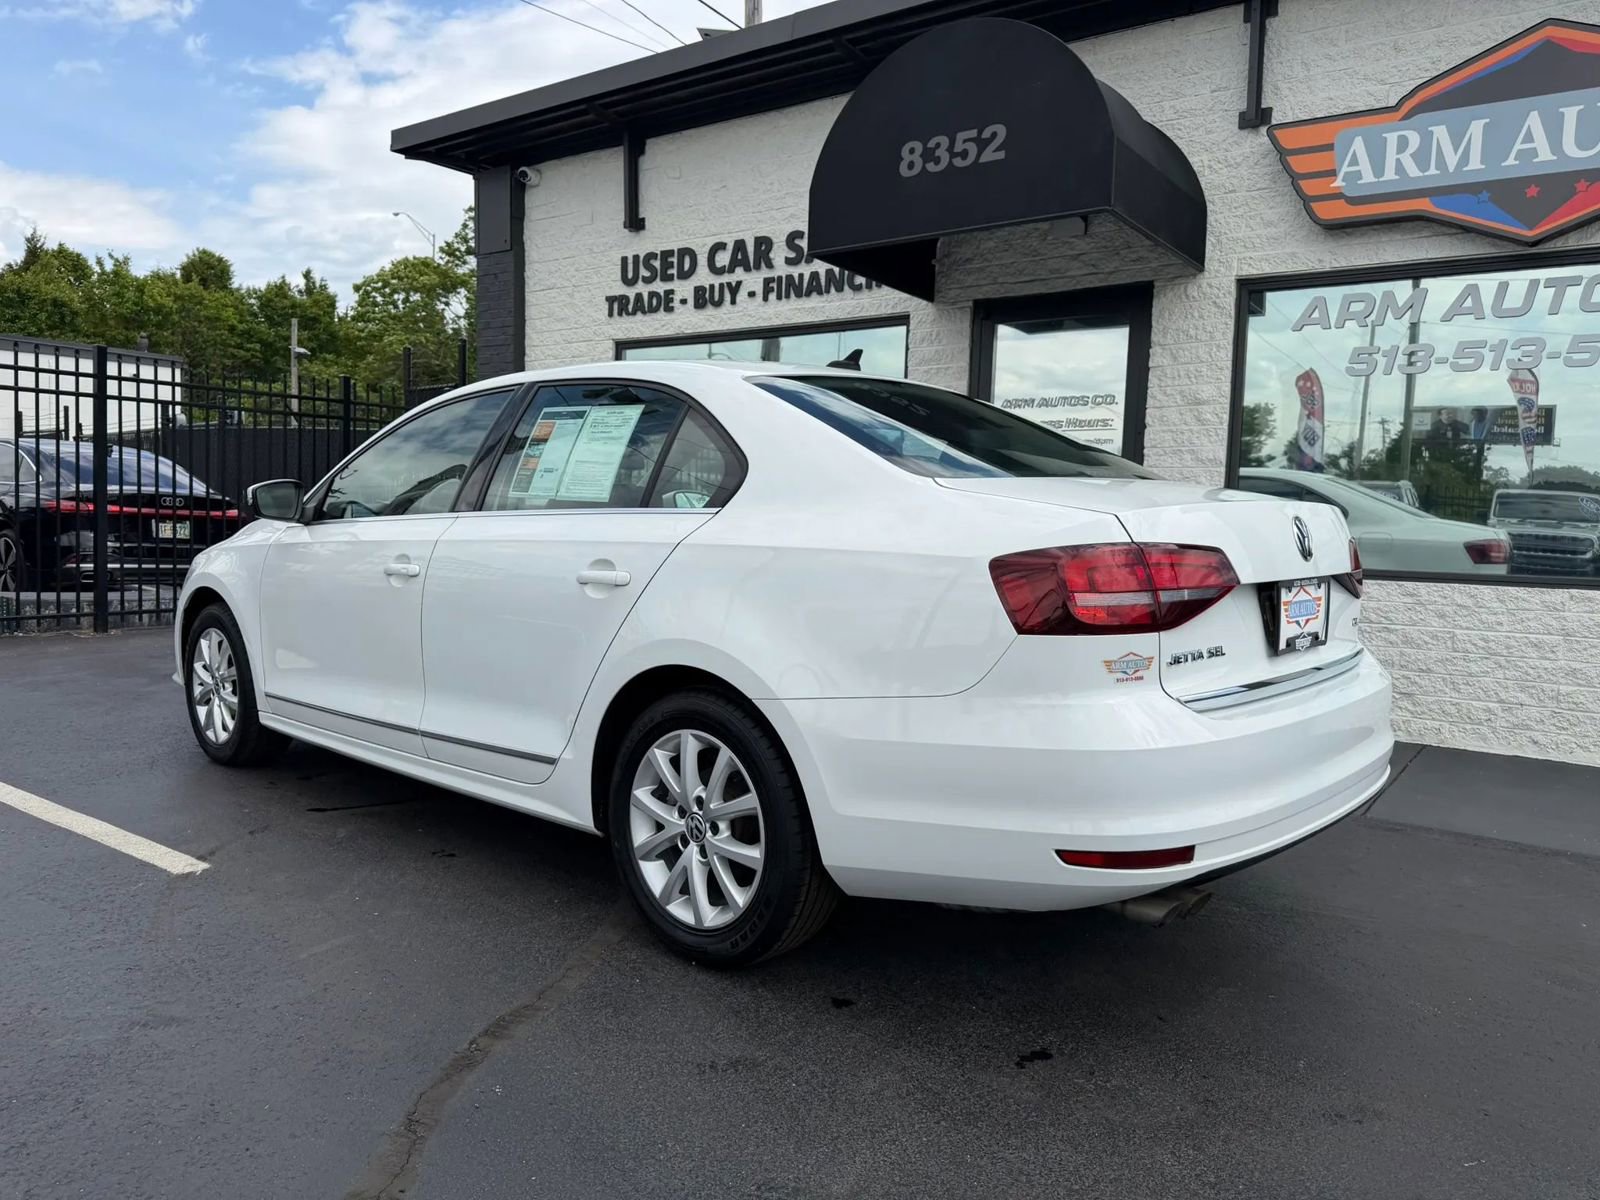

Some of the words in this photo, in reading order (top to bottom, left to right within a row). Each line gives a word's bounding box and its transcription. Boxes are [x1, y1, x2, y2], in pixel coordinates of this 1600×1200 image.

[899, 123, 1007, 178] 8352
[1330, 118, 1490, 188] ARM
[620, 247, 698, 287] USED
[707, 235, 774, 276] CAR
[785, 230, 815, 266] S
[605, 288, 675, 318] TRADE
[693, 280, 742, 310] BUY
[1291, 287, 1429, 332] ARM
[1001, 397, 1035, 409] ARM
[1036, 395, 1090, 408] AUTOS
[1167, 649, 1204, 667] JETTA
[1206, 645, 1226, 659] SEL
